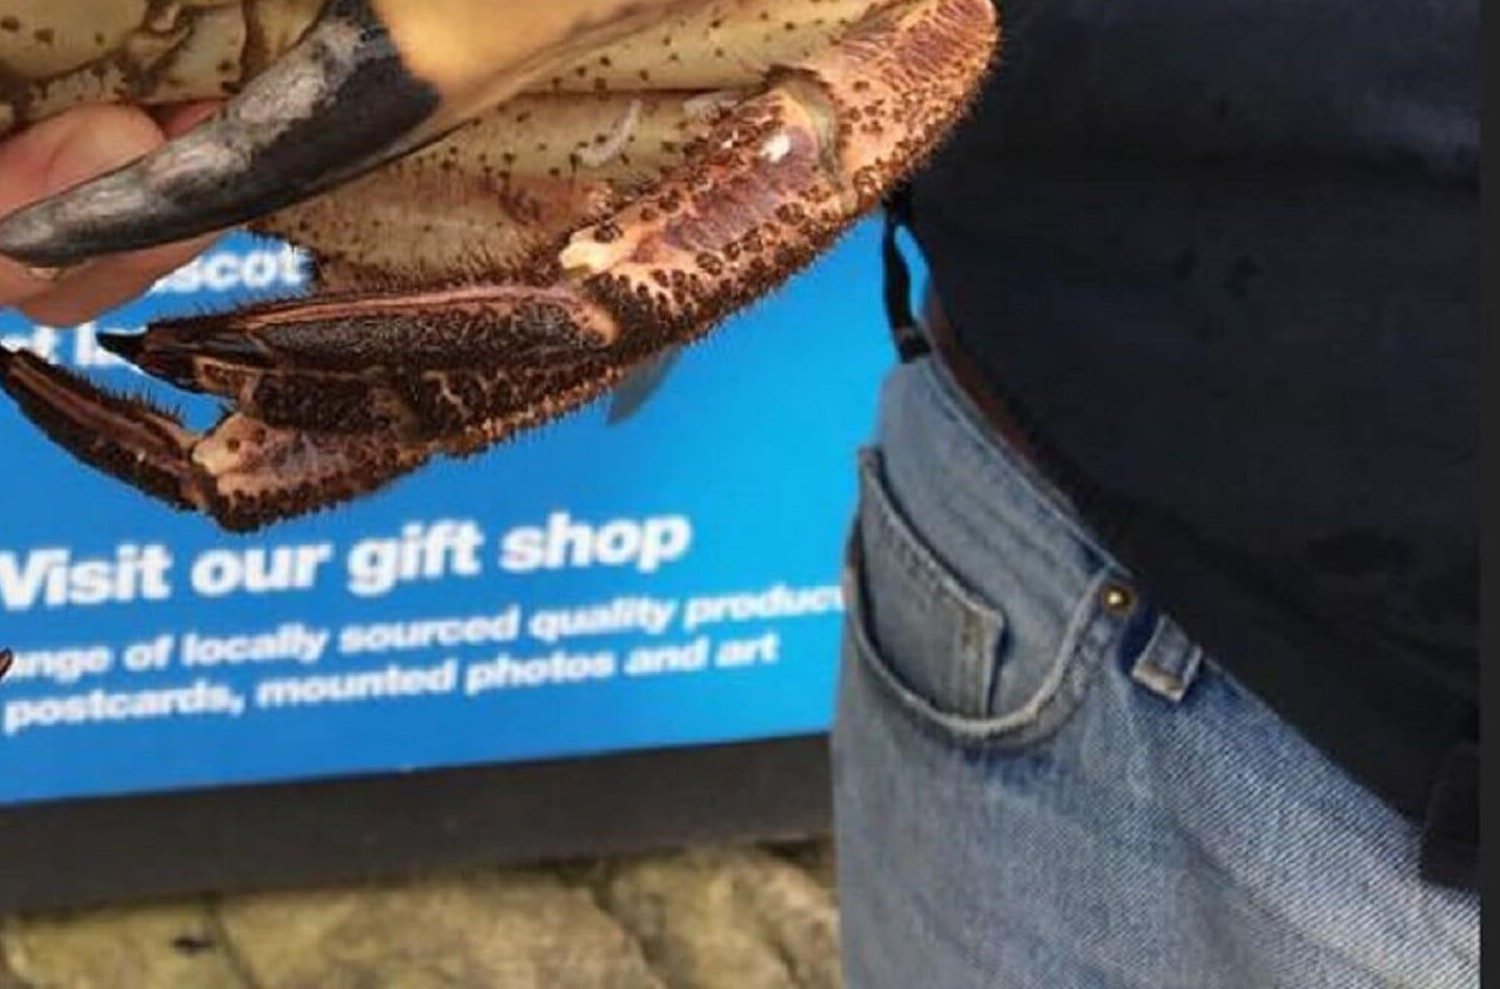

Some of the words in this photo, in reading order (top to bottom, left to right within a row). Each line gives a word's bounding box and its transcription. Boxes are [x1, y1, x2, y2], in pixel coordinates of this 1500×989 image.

[190, 541, 333, 599] our
[347, 518, 485, 599] gift
[499, 509, 693, 573] shop
[123, 634, 178, 673] of
[181, 621, 329, 666] locally
[338, 606, 518, 655] sourced
[529, 594, 676, 642] quality
[257, 657, 460, 710] mounted
[464, 647, 615, 696] photos
[624, 634, 707, 676] and
[715, 630, 781, 669] art
